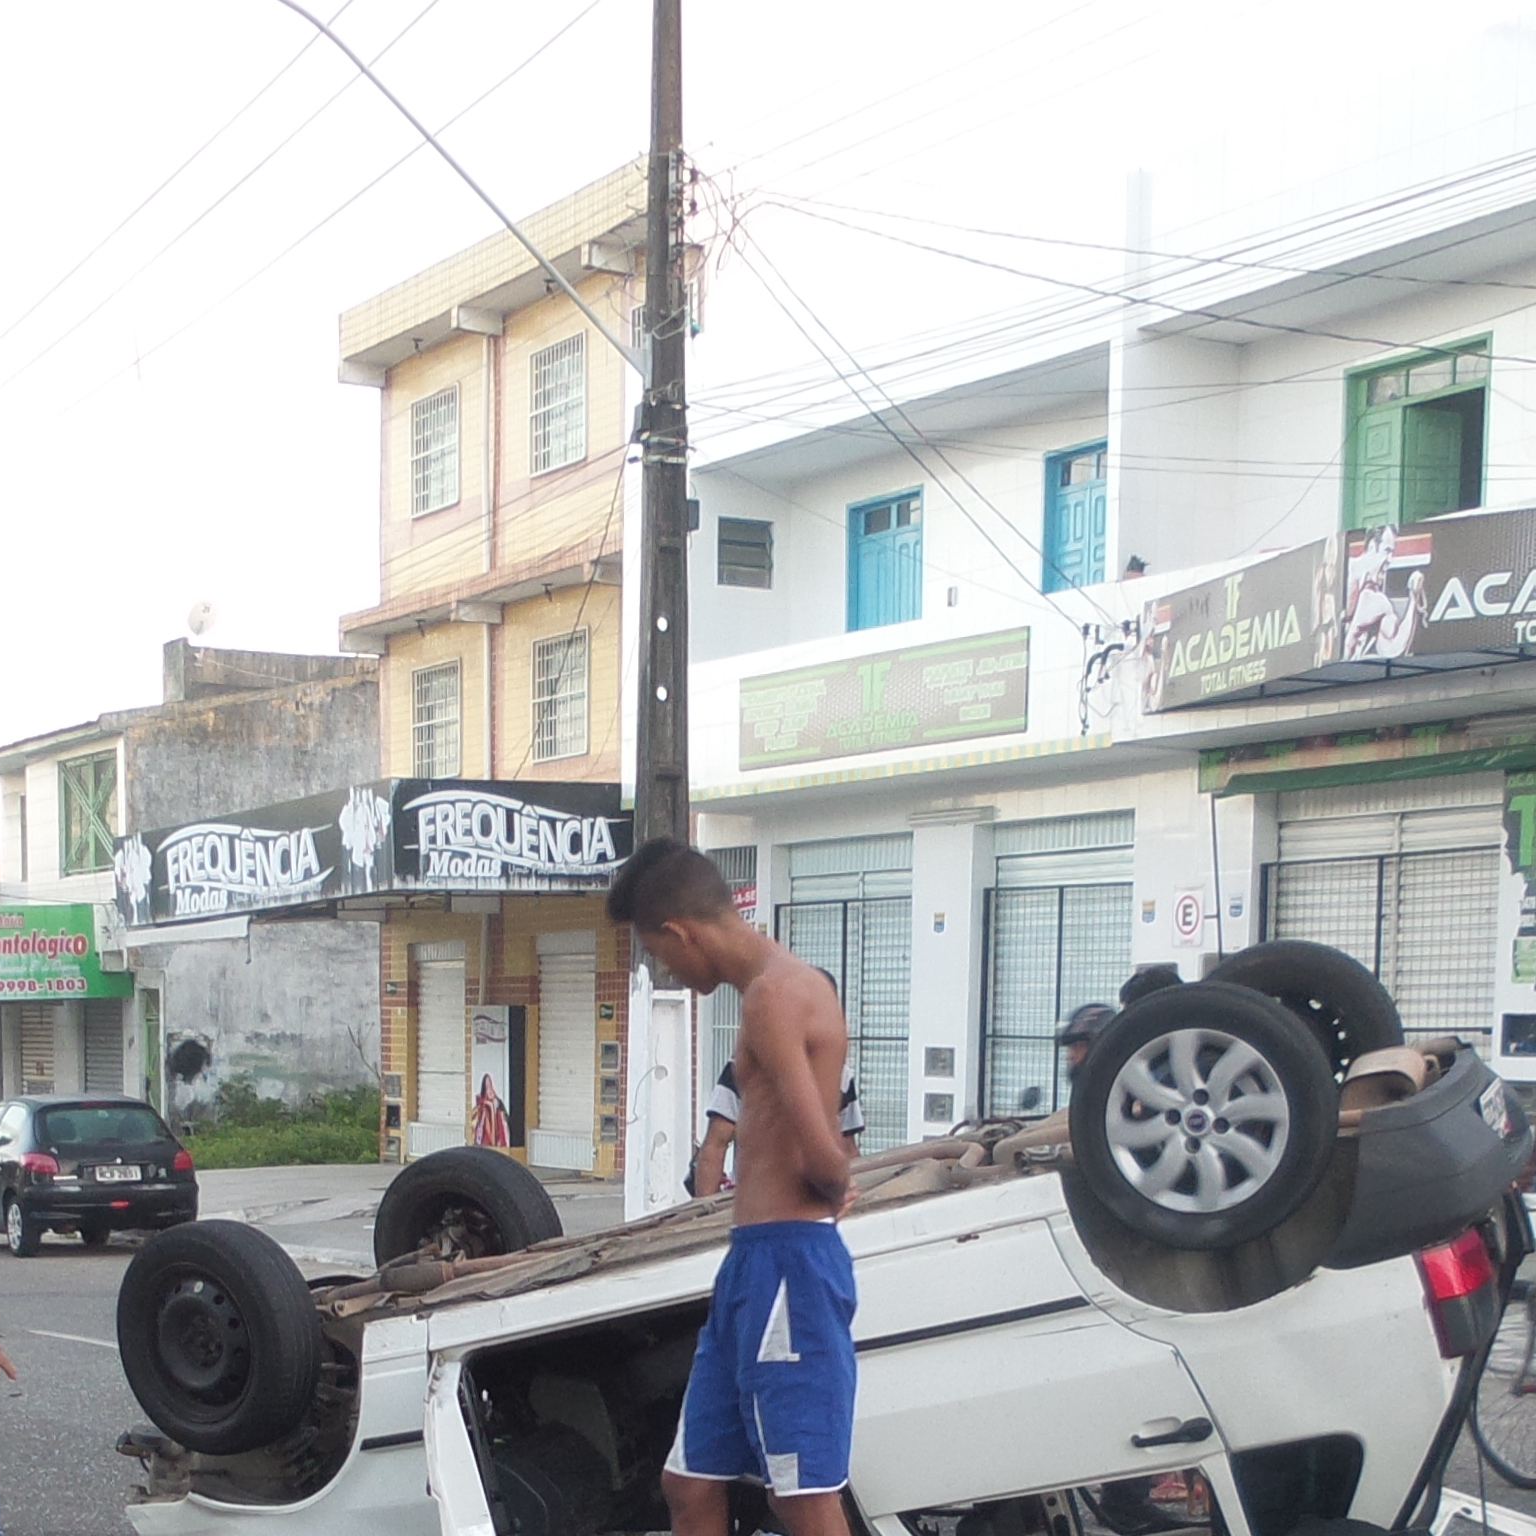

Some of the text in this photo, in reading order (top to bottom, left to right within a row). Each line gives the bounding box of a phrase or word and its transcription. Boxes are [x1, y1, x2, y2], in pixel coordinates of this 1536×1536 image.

[1168, 603, 1302, 680] ACADEMIA
[1200, 659, 1268, 695] TOTAL FITNESS
[826, 710, 920, 738] ACADEMIA
[839, 734, 868, 750] TOTAL
[418, 798, 615, 866] FREQUÊNCIA
[166, 827, 321, 891] FREQUÊNCIA
[425, 850, 503, 878] Modas
[175, 886, 228, 915] Modas
[1181, 903, 1193, 927] E
